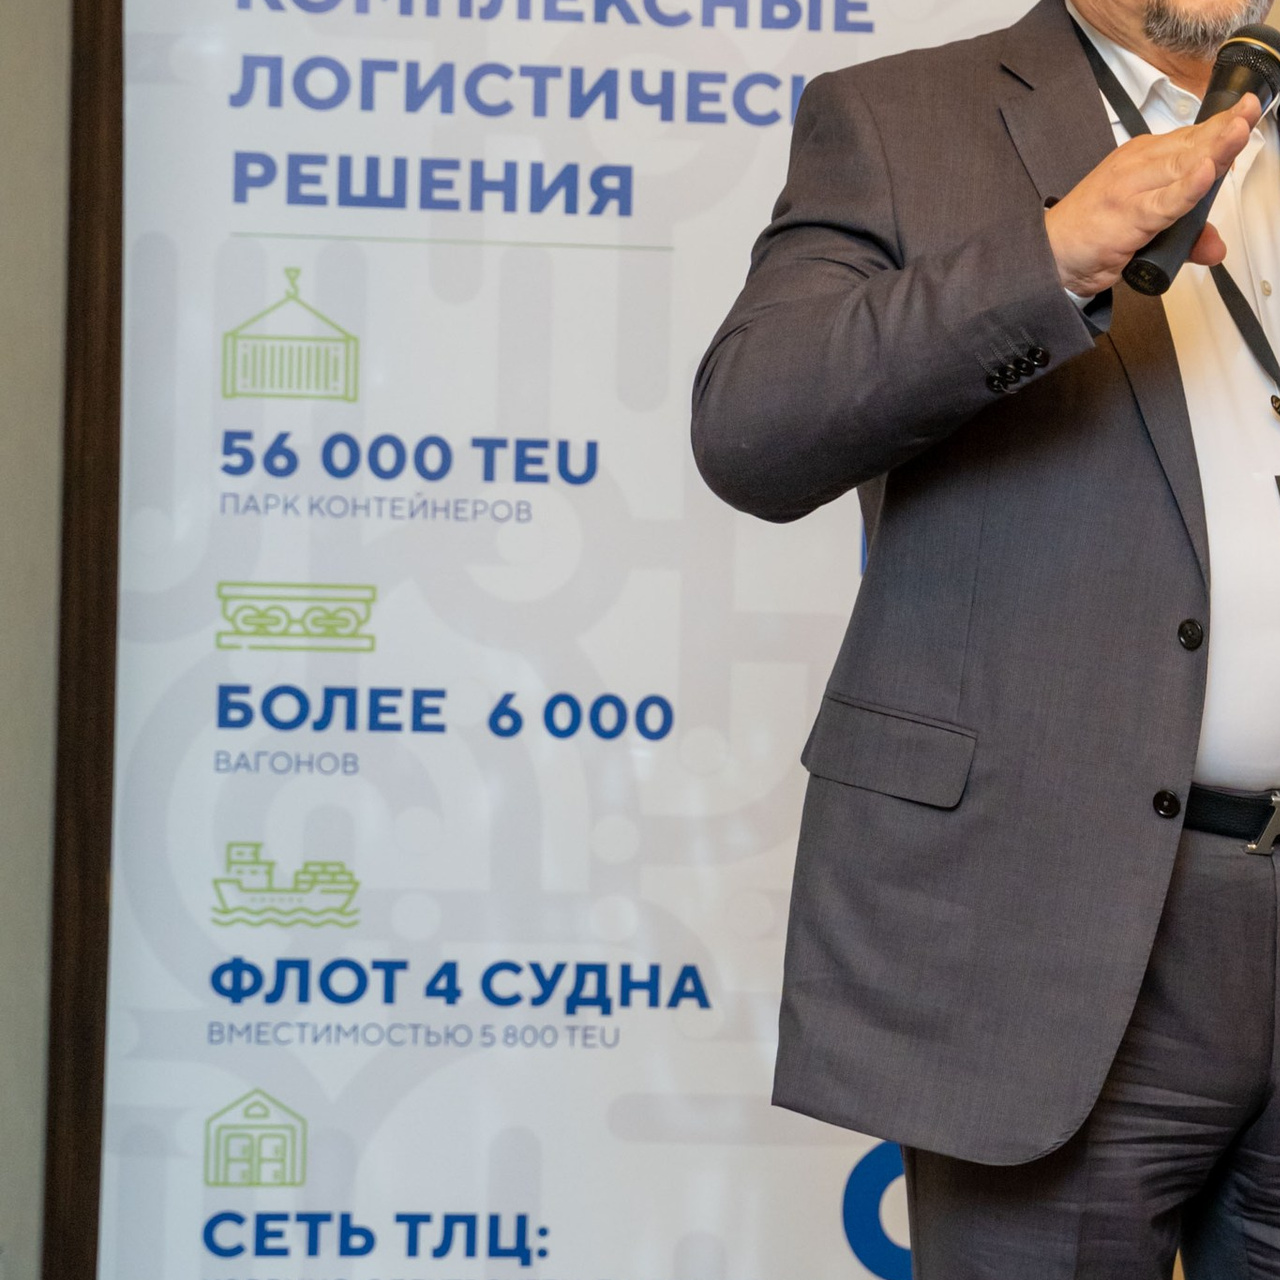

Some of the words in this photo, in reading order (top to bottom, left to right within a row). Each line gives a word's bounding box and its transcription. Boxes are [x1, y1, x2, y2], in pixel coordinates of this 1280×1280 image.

[230, 55, 804, 126] ЛОГИСТИЧЕС
[234, 152, 632, 217] РЕШЕНИЯ
[221, 431, 299, 478] 56
[321, 433, 452, 481] 000
[472, 438, 597, 485] TEU
[220, 492, 301, 519] ПАРК
[308, 492, 532, 524] КОНТЕЙНЕРОВ
[218, 685, 446, 733] БОЛЕЕ
[488, 693, 523, 738] 6
[543, 693, 673, 740] 000
[214, 750, 359, 775] ВАГОНОВ
[211, 957, 408, 1005] ФЛОТ
[425, 962, 461, 1005] 4
[481, 961, 710, 1016] СУДНА
[207, 1021, 473, 1047] ВМЕСТИМОСТЬЮ
[480, 1024, 496, 1048] 5
[502, 1025, 558, 1048] 800
[565, 1025, 620, 1049] TEU
[203, 1212, 375, 1258] СЕТЬ
[395, 1213, 548, 1267] ТЛЦ:
